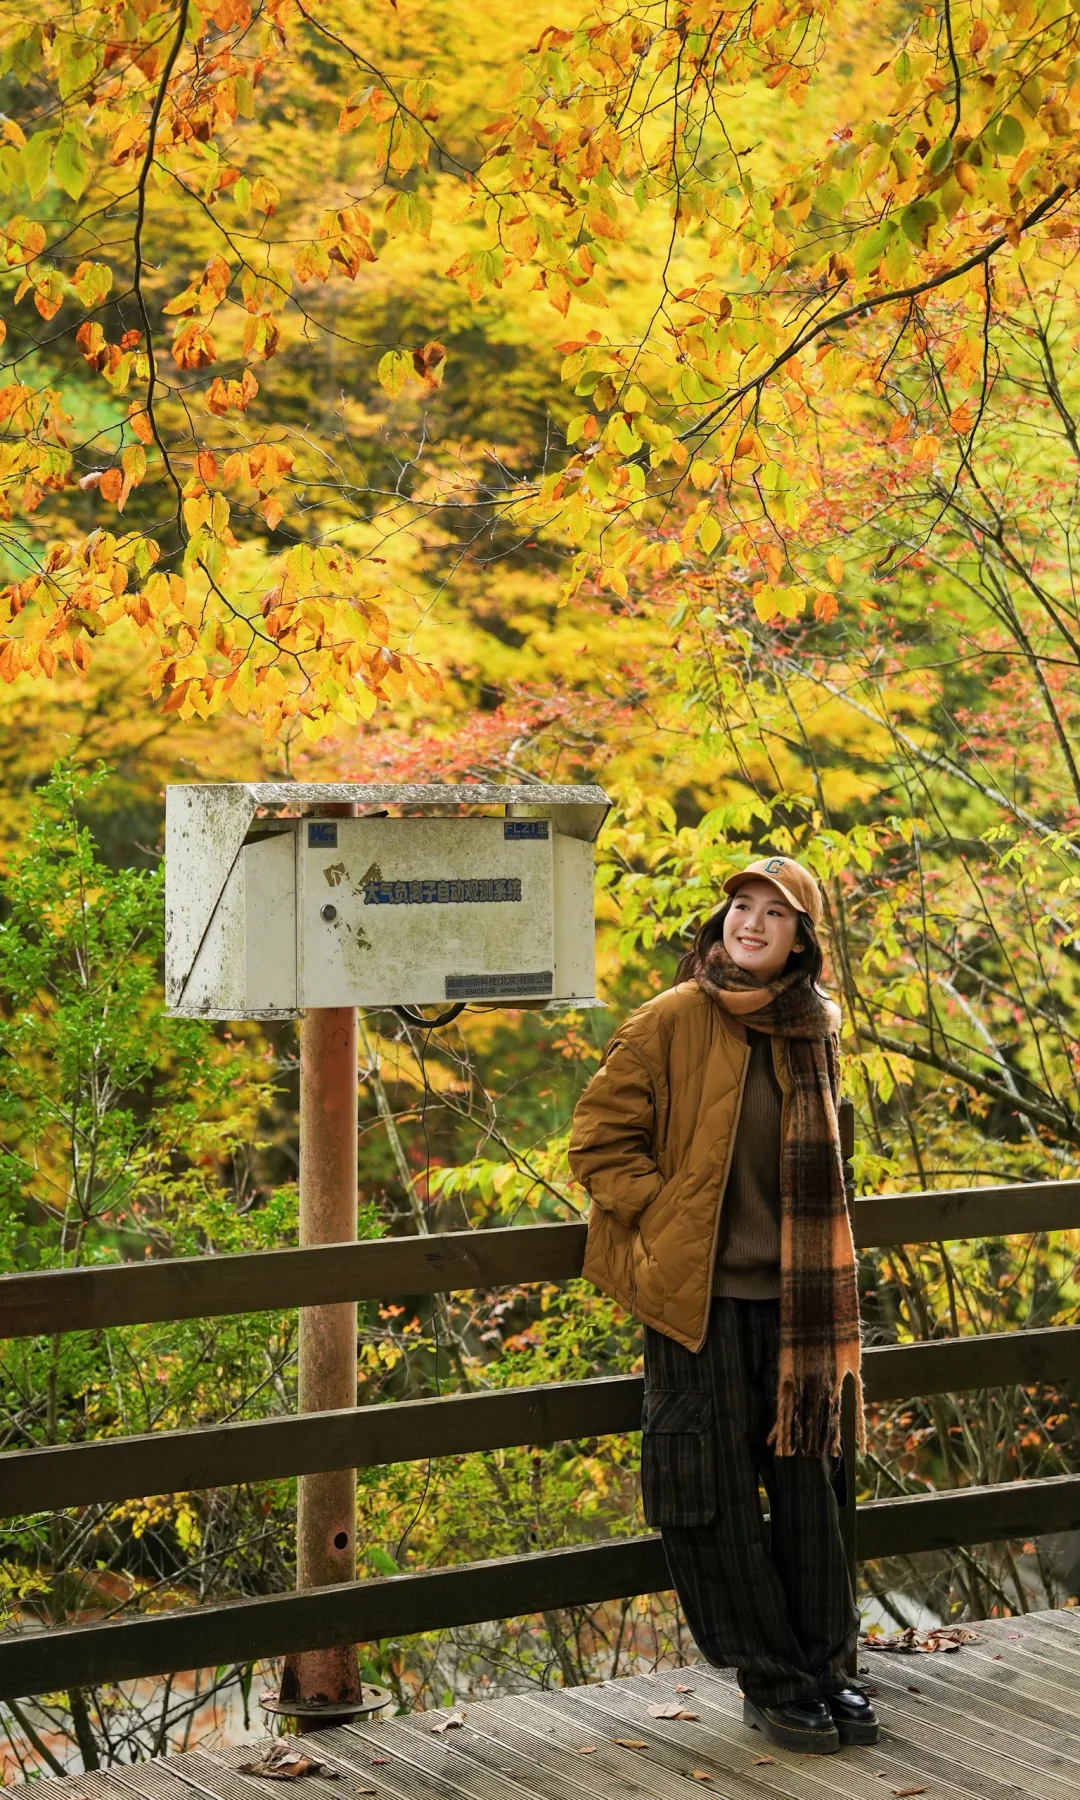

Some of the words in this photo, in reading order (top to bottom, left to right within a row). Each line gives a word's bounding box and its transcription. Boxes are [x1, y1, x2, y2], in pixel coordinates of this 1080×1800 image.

[505, 821, 549, 834] FLZ1型
[764, 859, 785, 874] C
[364, 879, 522, 904] 大气负离子自动观测系统
[500, 985, 552, 994] www.bjwide.com
